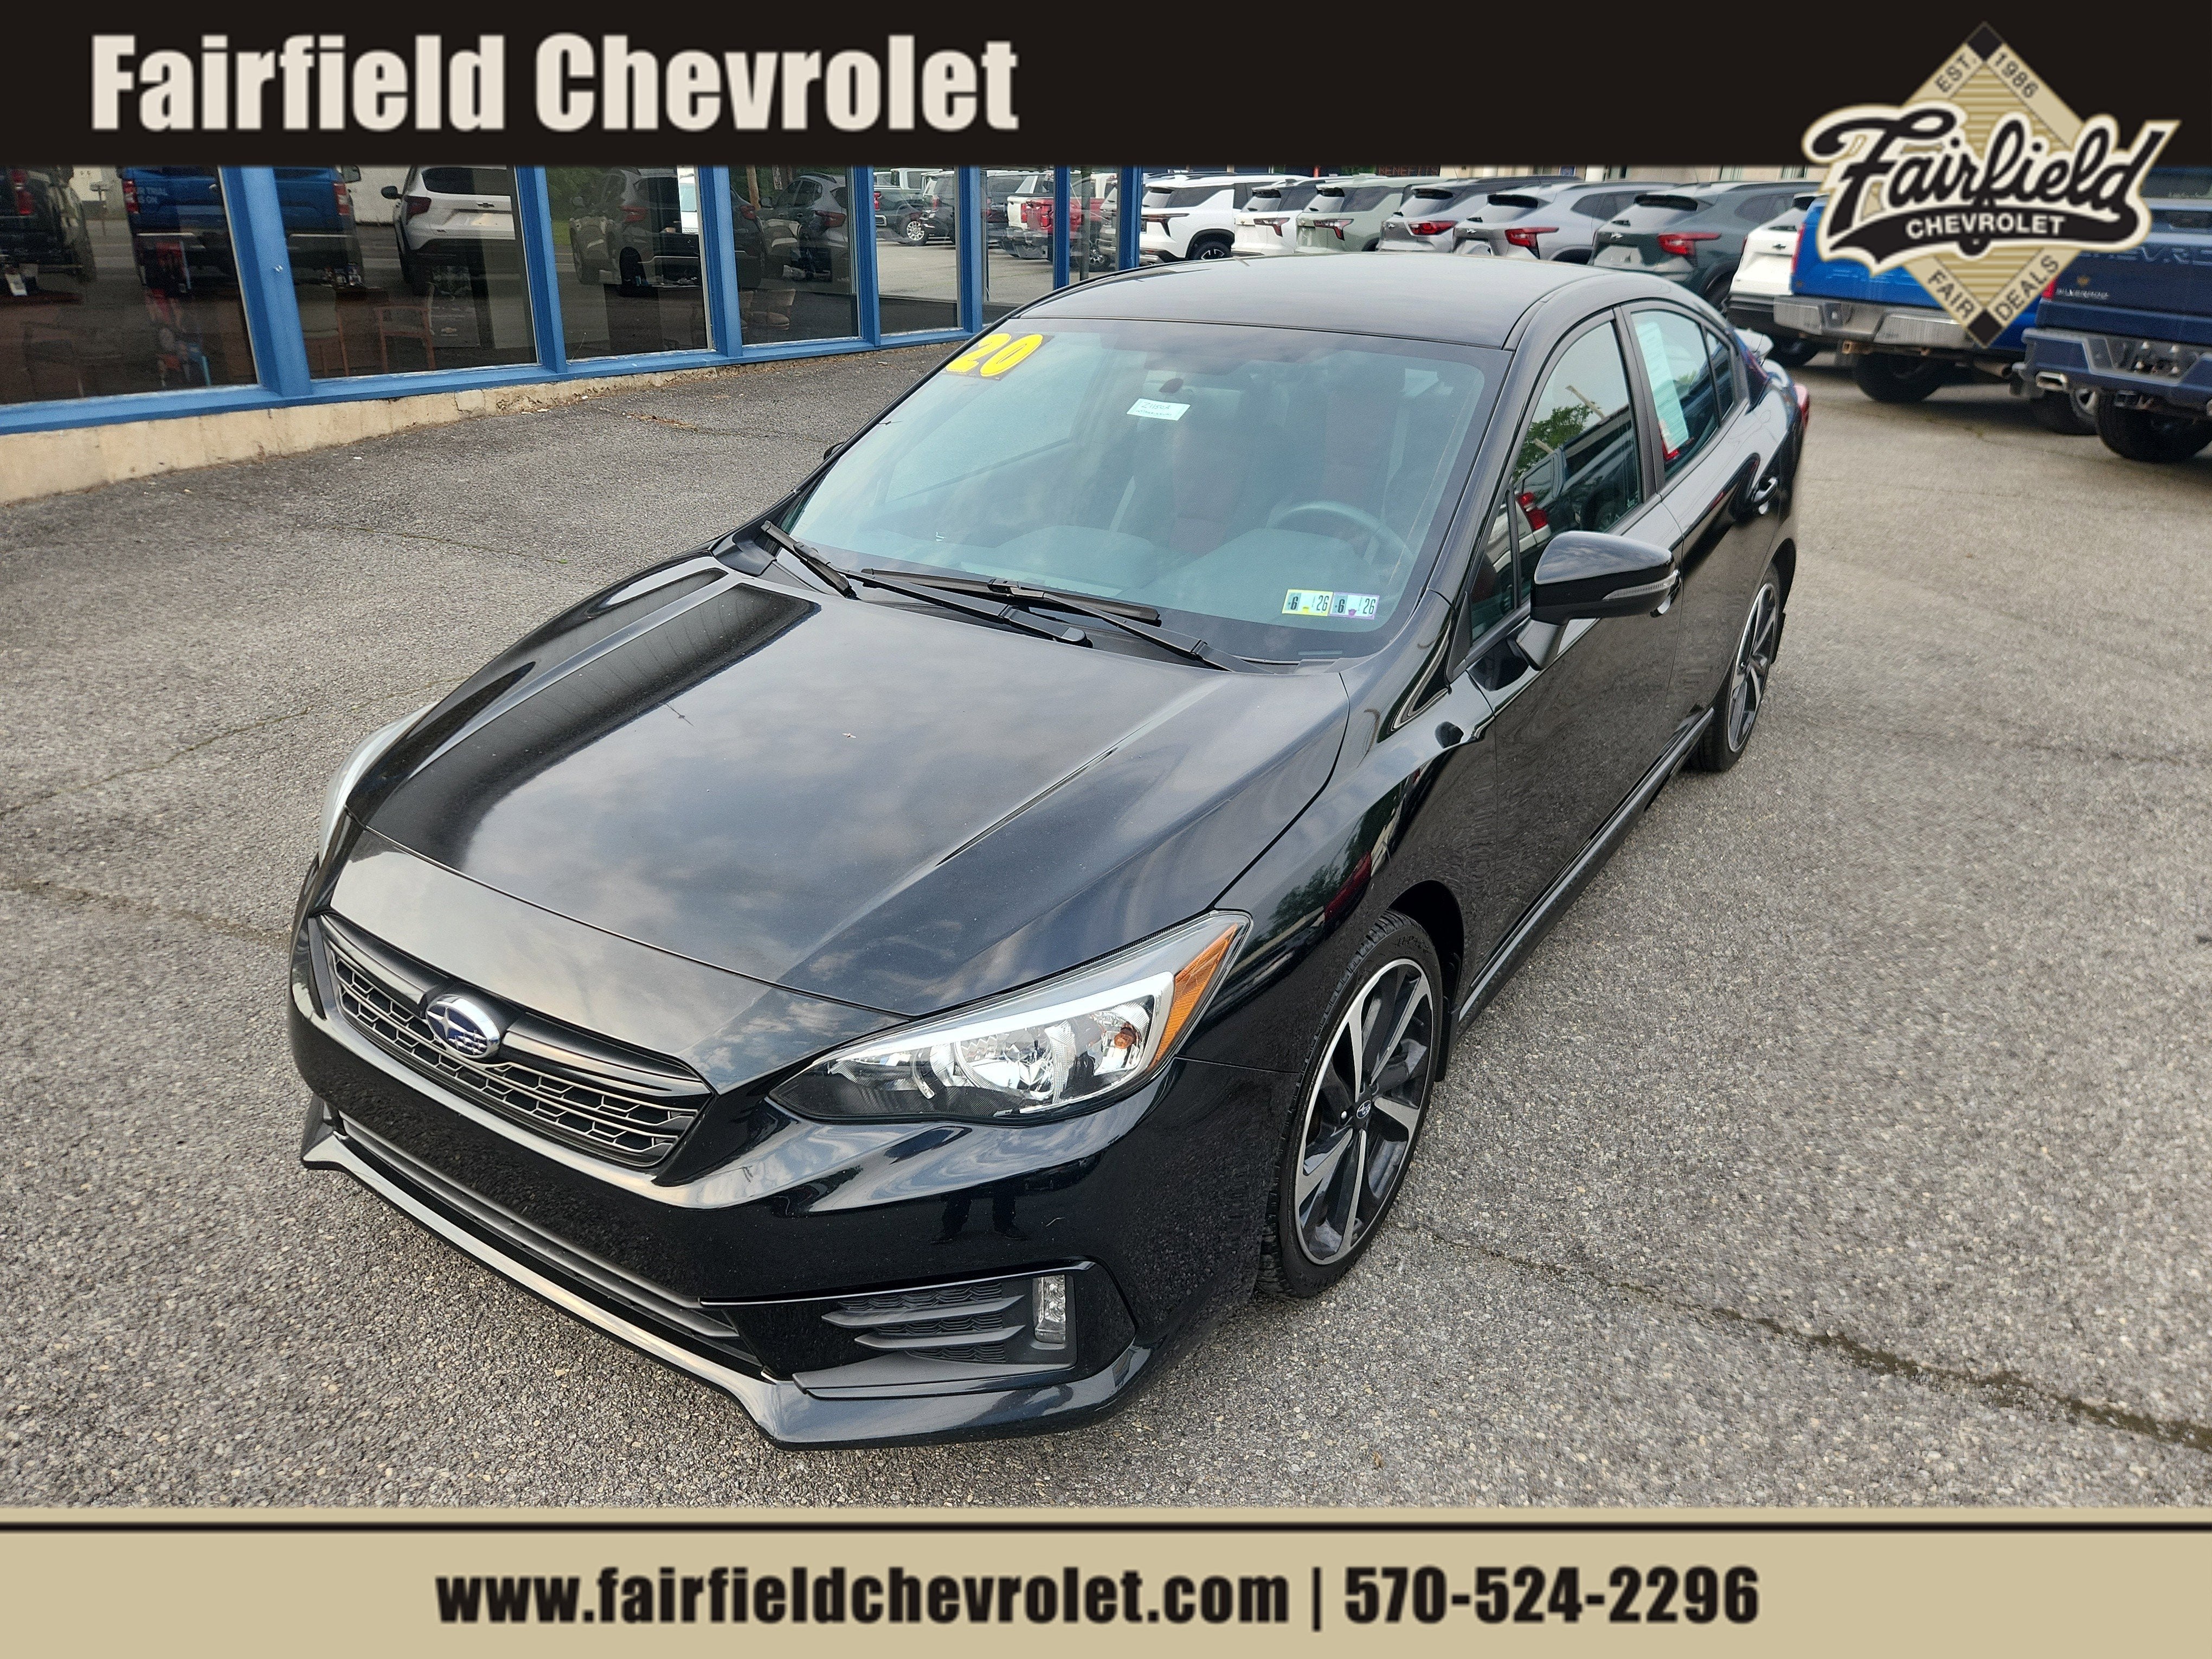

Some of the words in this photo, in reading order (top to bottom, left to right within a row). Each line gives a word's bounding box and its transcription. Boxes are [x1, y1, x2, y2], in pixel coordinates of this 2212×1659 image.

[946, 333, 1044, 377] 20
[1290, 596, 1299, 610] 6
[1316, 595, 1330, 612] 26
[1337, 599, 1346, 614] 6
[1362, 598, 1377, 615] 26
